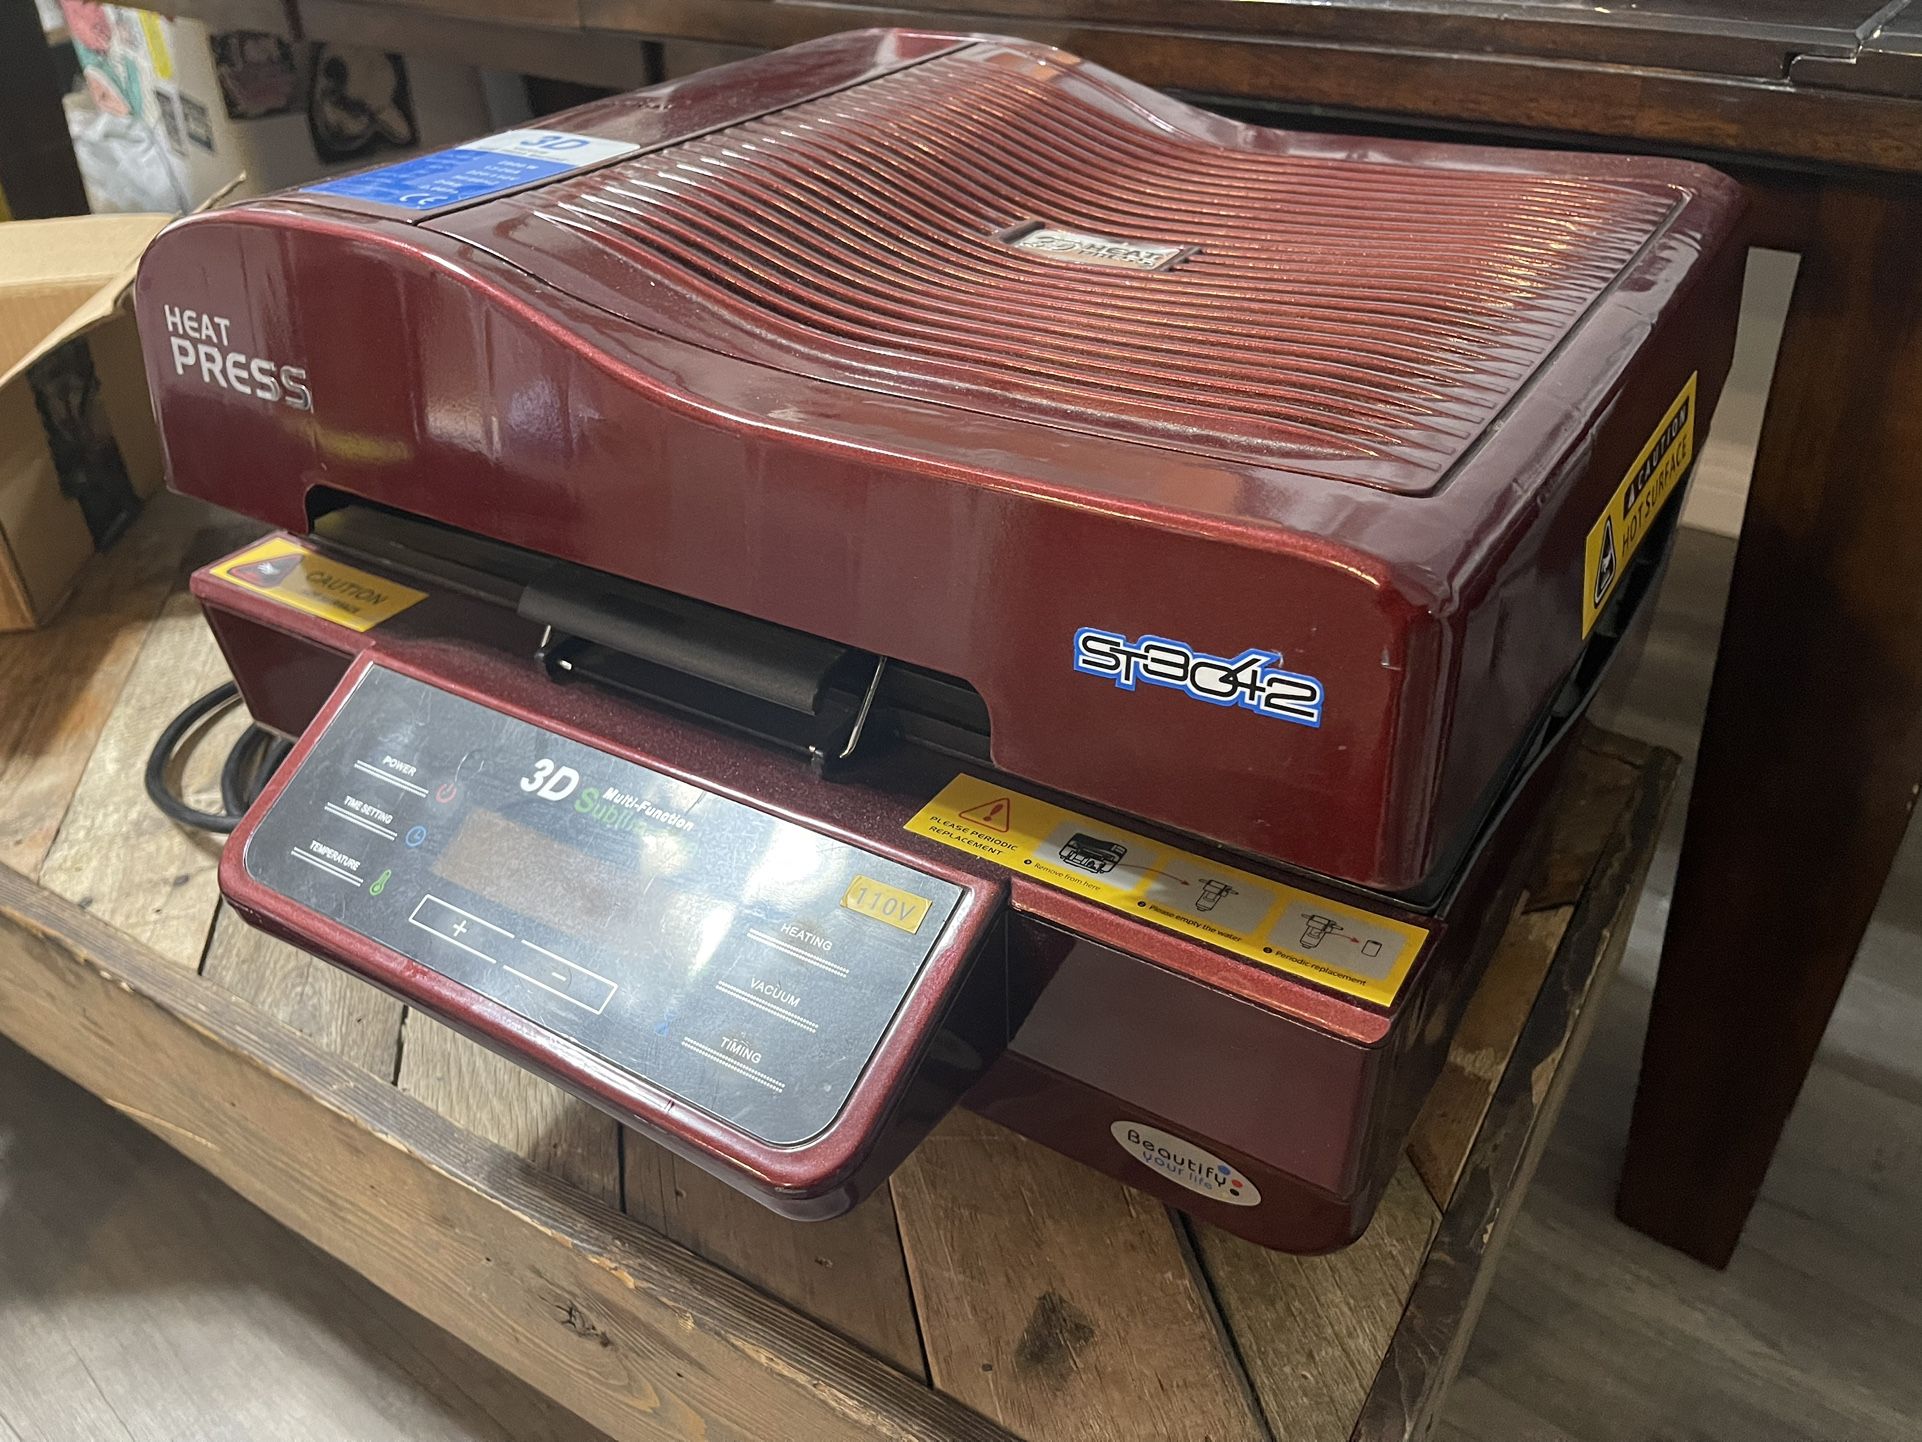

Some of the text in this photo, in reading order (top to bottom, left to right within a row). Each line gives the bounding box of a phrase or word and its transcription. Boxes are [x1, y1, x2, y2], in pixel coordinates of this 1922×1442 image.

[520, 136, 590, 150] 3D
[1083, 243, 1164, 261] HEAT
[164, 304, 230, 346] HEAT
[170, 336, 313, 411] PRESS
[1638, 404, 1687, 491] CAUTION
[1621, 433, 1688, 557] HOT SURFACE
[306, 571, 388, 605] CAUTION
[1081, 634, 1318, 719] ST3042
[382, 755, 417, 777] POWER
[520, 758, 580, 802] 3D
[343, 795, 394, 825] TIME SETTING
[602, 786, 695, 832] Multi-Function
[928, 826, 1004, 856] REPLACEMENT
[929, 816, 1018, 852] PLEASE PERIODIC
[309, 839, 361, 871] TEMPERATURE
[1034, 862, 1101, 891] Remove from here
[856, 886, 916, 922] 110V
[780, 923, 833, 951] HEATING
[1149, 904, 1242, 942] Please empty the water
[1275, 950, 1367, 986] Periodic replacement
[750, 977, 800, 1008] VACUUM
[720, 1036, 762, 1064] TIMING
[1128, 1129, 1227, 1187] Beautify
[1143, 1151, 1213, 1190] your life
